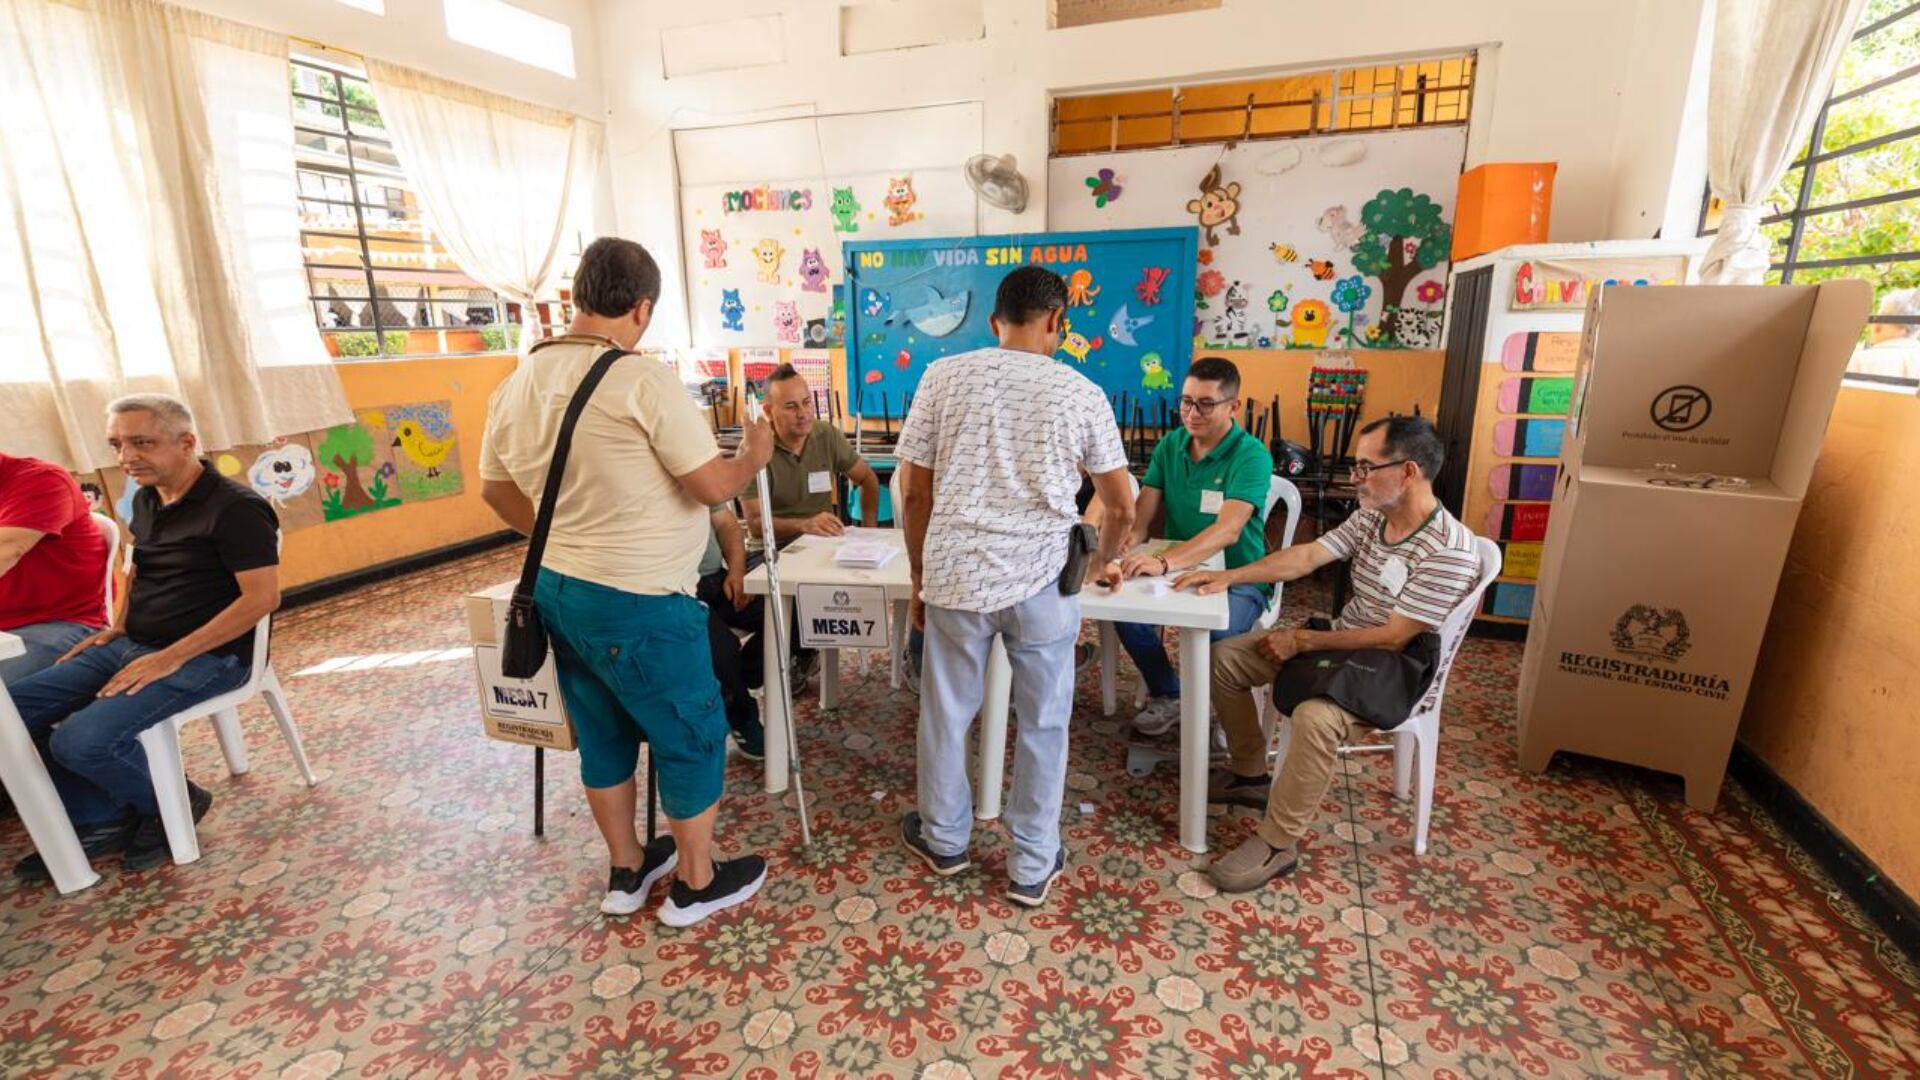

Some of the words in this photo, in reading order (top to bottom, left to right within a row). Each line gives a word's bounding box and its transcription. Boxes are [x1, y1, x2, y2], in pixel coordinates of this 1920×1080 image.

[859, 251, 884, 268] NO
[933, 248, 979, 267] VIDA
[985, 246, 1023, 266] SIN
[1029, 244, 1088, 264] AGUA
[812, 618, 861, 636] MESA
[863, 620, 875, 637] 7
[1557, 664, 1613, 680] NACIONAL
[1616, 673, 1643, 685] DEL
[1644, 677, 1693, 694] ESTADO
[1694, 687, 1729, 701] CIVIL
[1559, 651, 1731, 693] REGISTRADURÍA
[493, 685, 538, 709] MESA
[537, 691, 549, 710] 7
